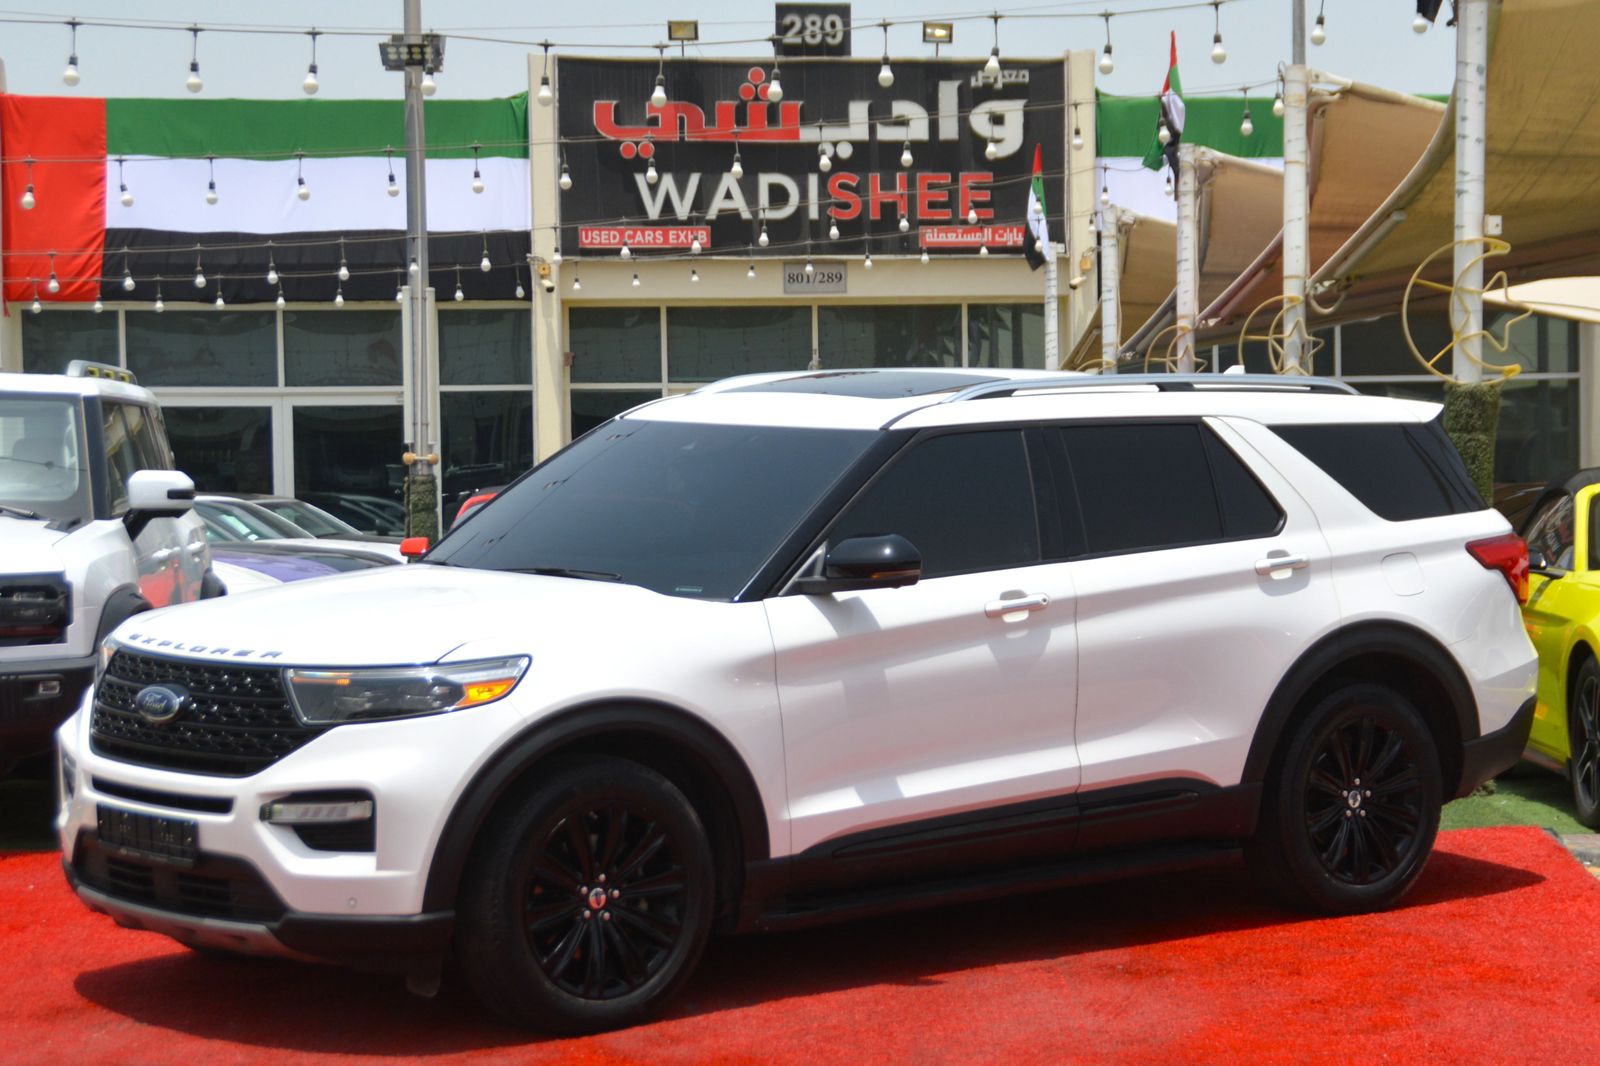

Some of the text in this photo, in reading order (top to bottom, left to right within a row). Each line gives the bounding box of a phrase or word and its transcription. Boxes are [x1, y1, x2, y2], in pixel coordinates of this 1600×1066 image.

[782, 14, 844, 45] 289
[633, 171, 995, 221] WADISHEE
[582, 230, 620, 244] USED
[624, 230, 664, 244] CARS
[787, 271, 843, 284] 801/289
[128, 633, 283, 659] EXPLORER
